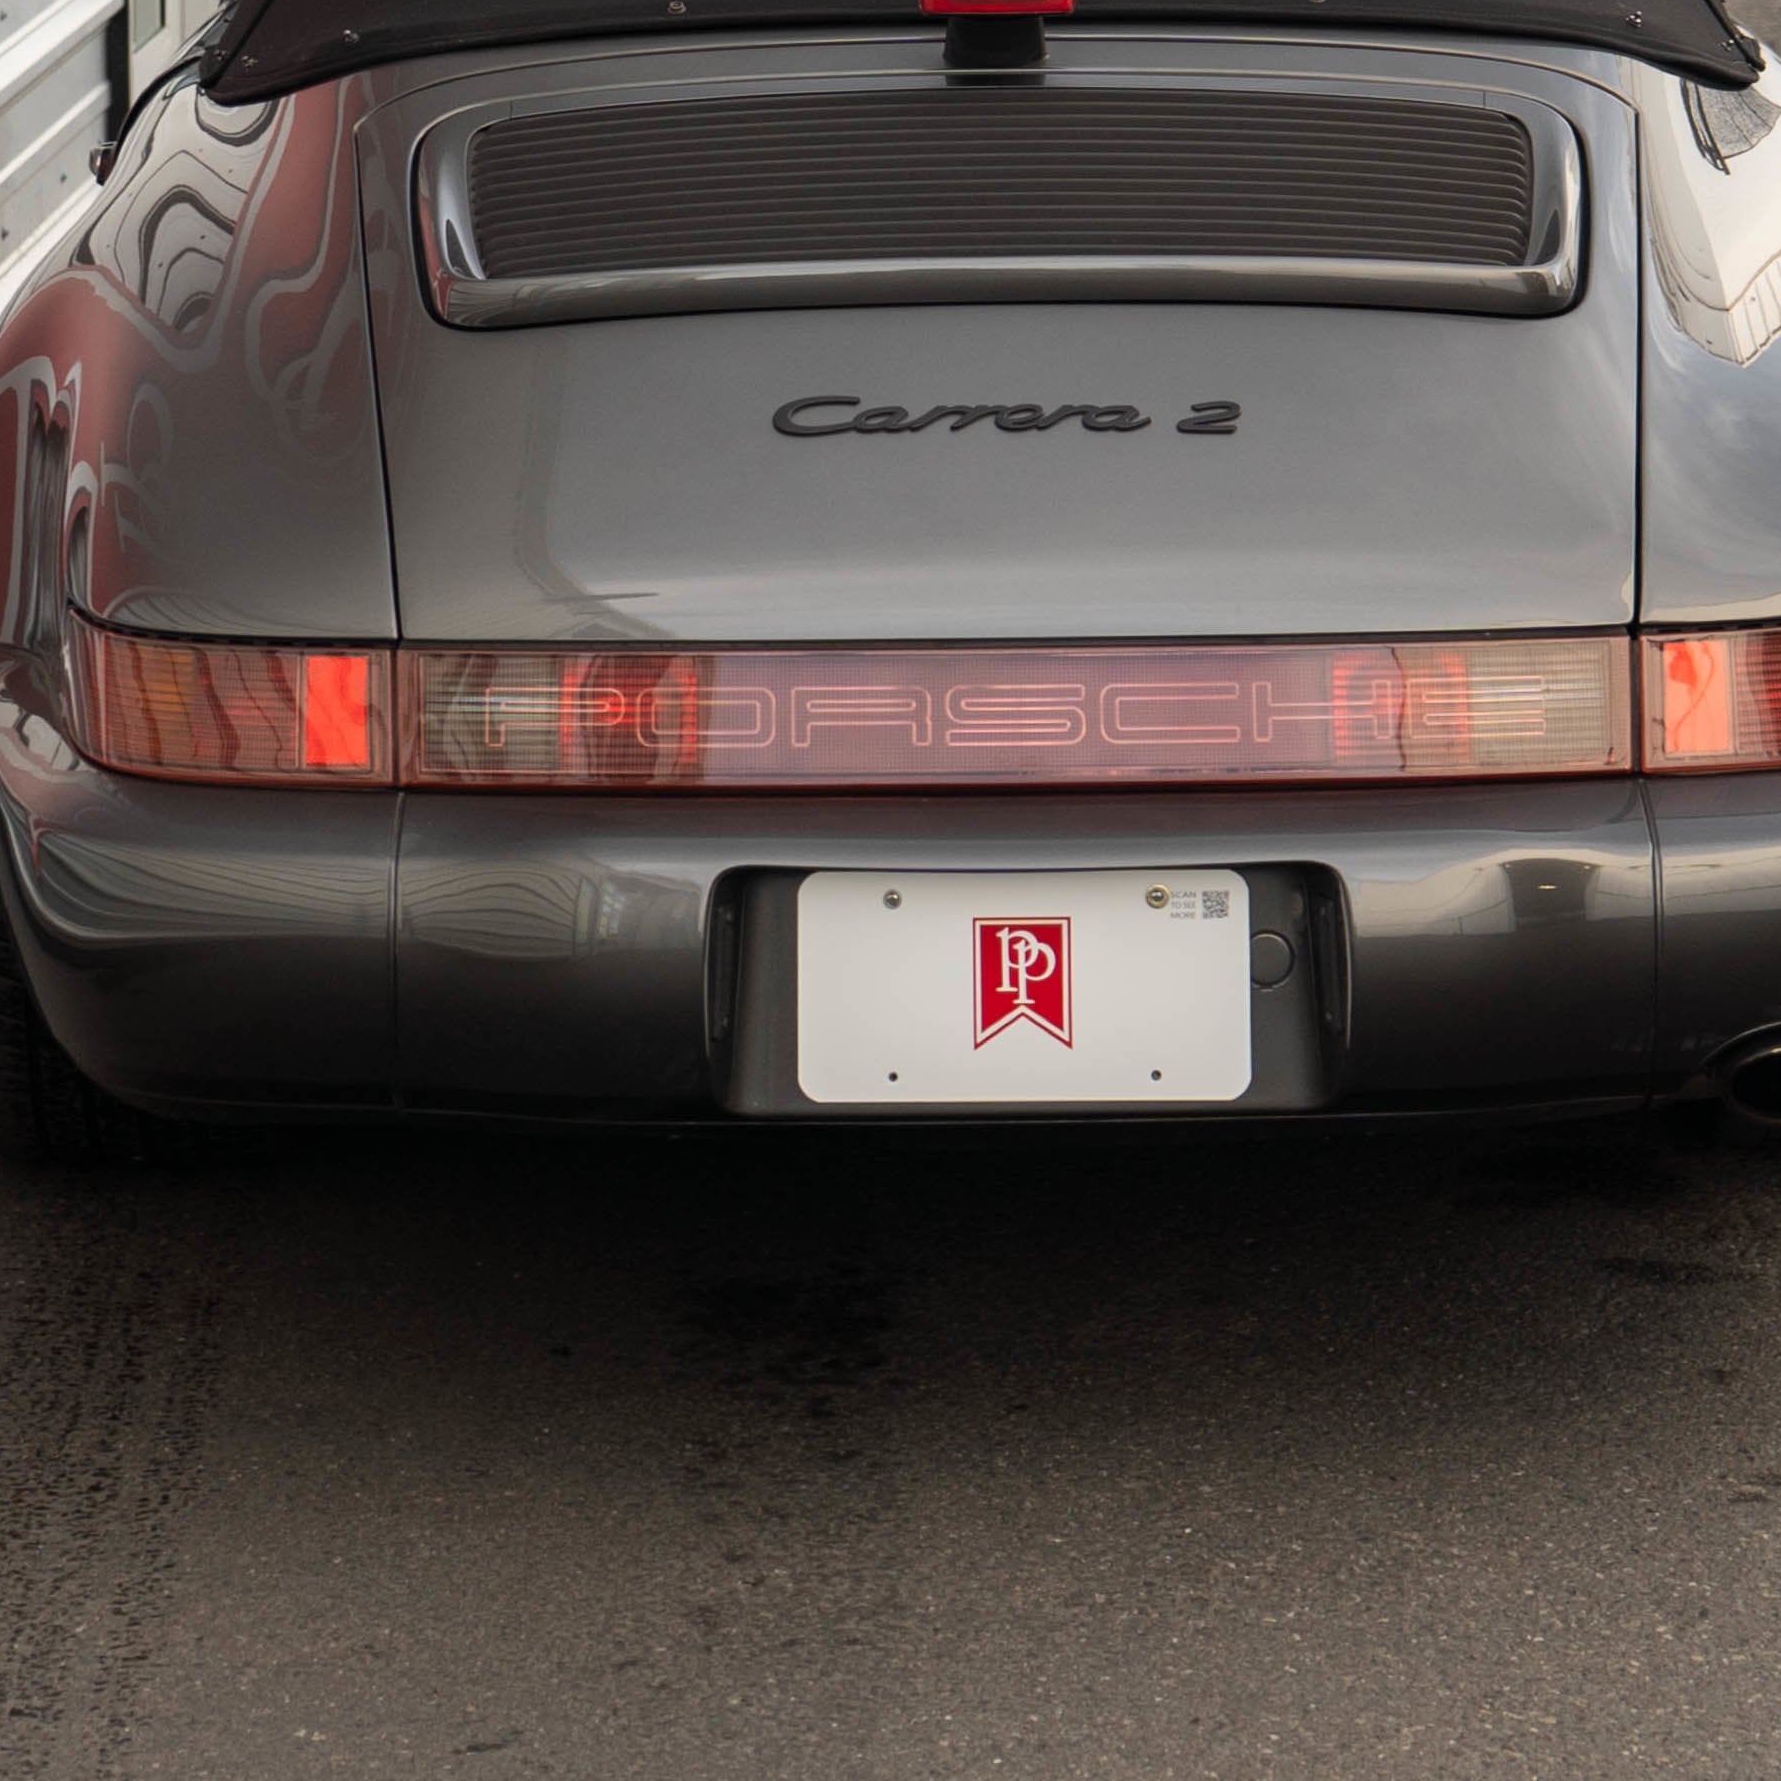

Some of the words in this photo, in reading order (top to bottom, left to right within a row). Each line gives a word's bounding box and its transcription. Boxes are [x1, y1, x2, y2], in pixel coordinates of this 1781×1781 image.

[772, 394, 1152, 437] Carrera
[1175, 399, 1242, 435] 2
[482, 673, 1546, 747] PORSCHE
[1170, 890, 1197, 899] SCAN
[1170, 911, 1196, 919] MORE
